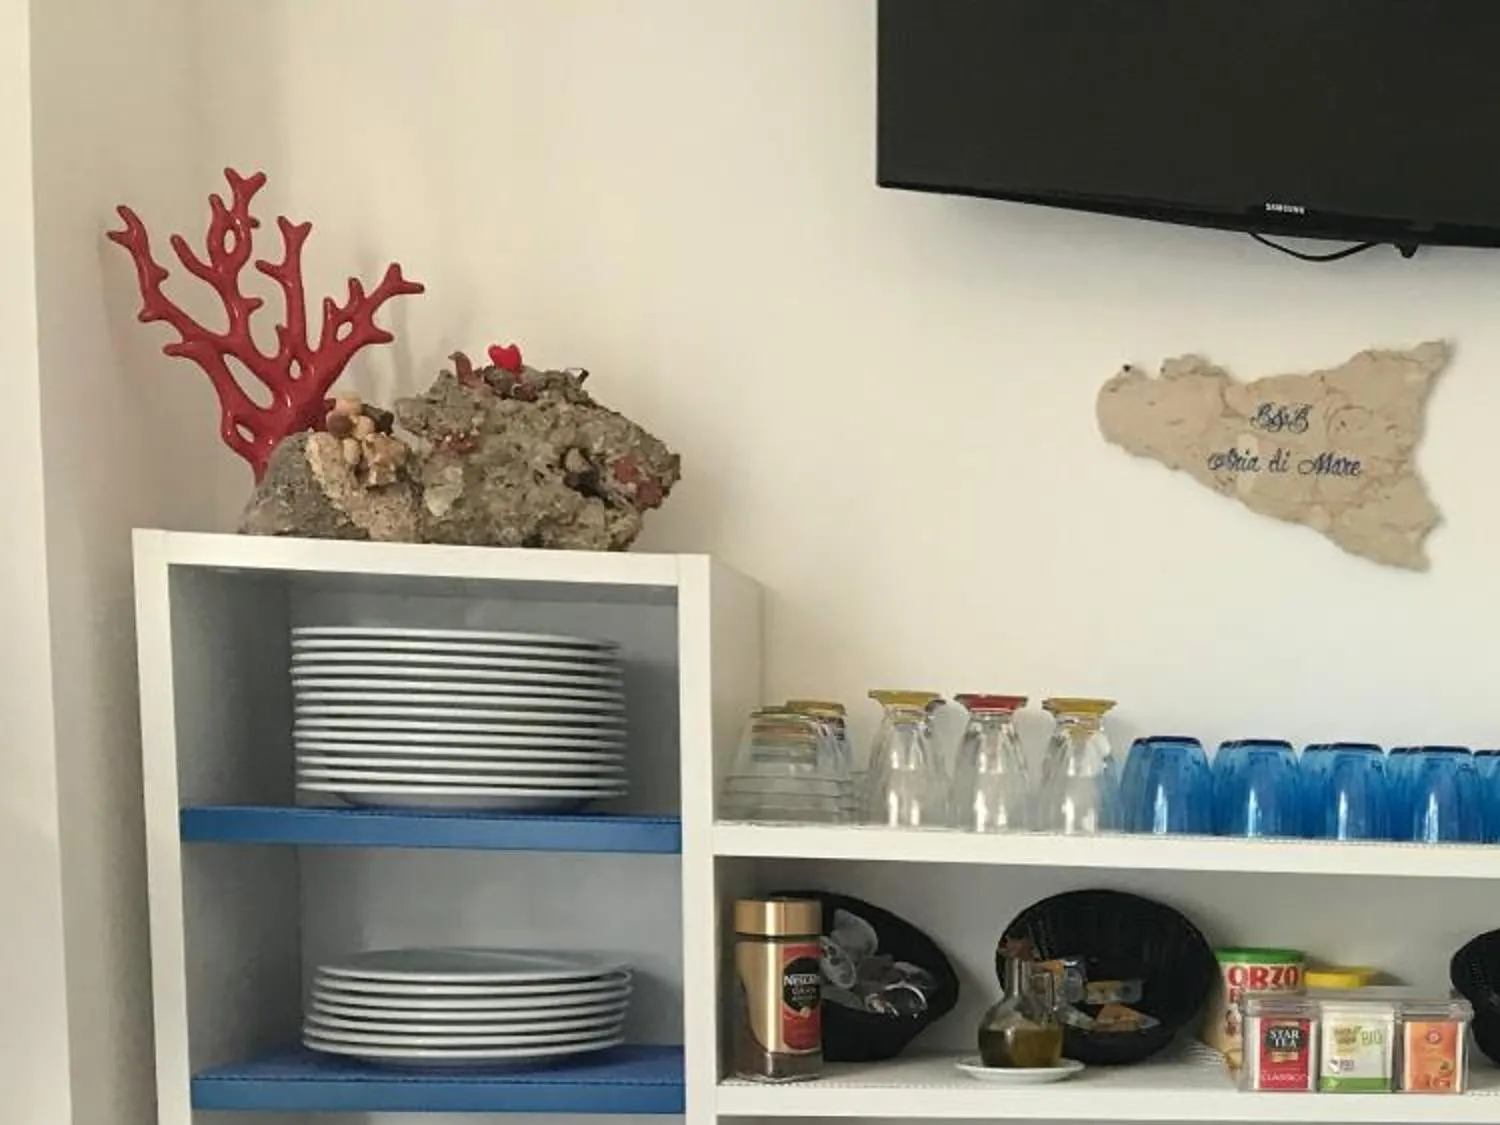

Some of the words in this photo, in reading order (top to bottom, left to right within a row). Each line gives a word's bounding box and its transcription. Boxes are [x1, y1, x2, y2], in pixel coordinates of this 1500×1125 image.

[1207, 447, 1261, 474] Aria
[1268, 448, 1290, 474] di
[1298, 451, 1362, 477] Mare
[1228, 966, 1298, 991] ORZO
[1270, 1028, 1300, 1039] STAR
[1275, 1038, 1298, 1049] TEA
